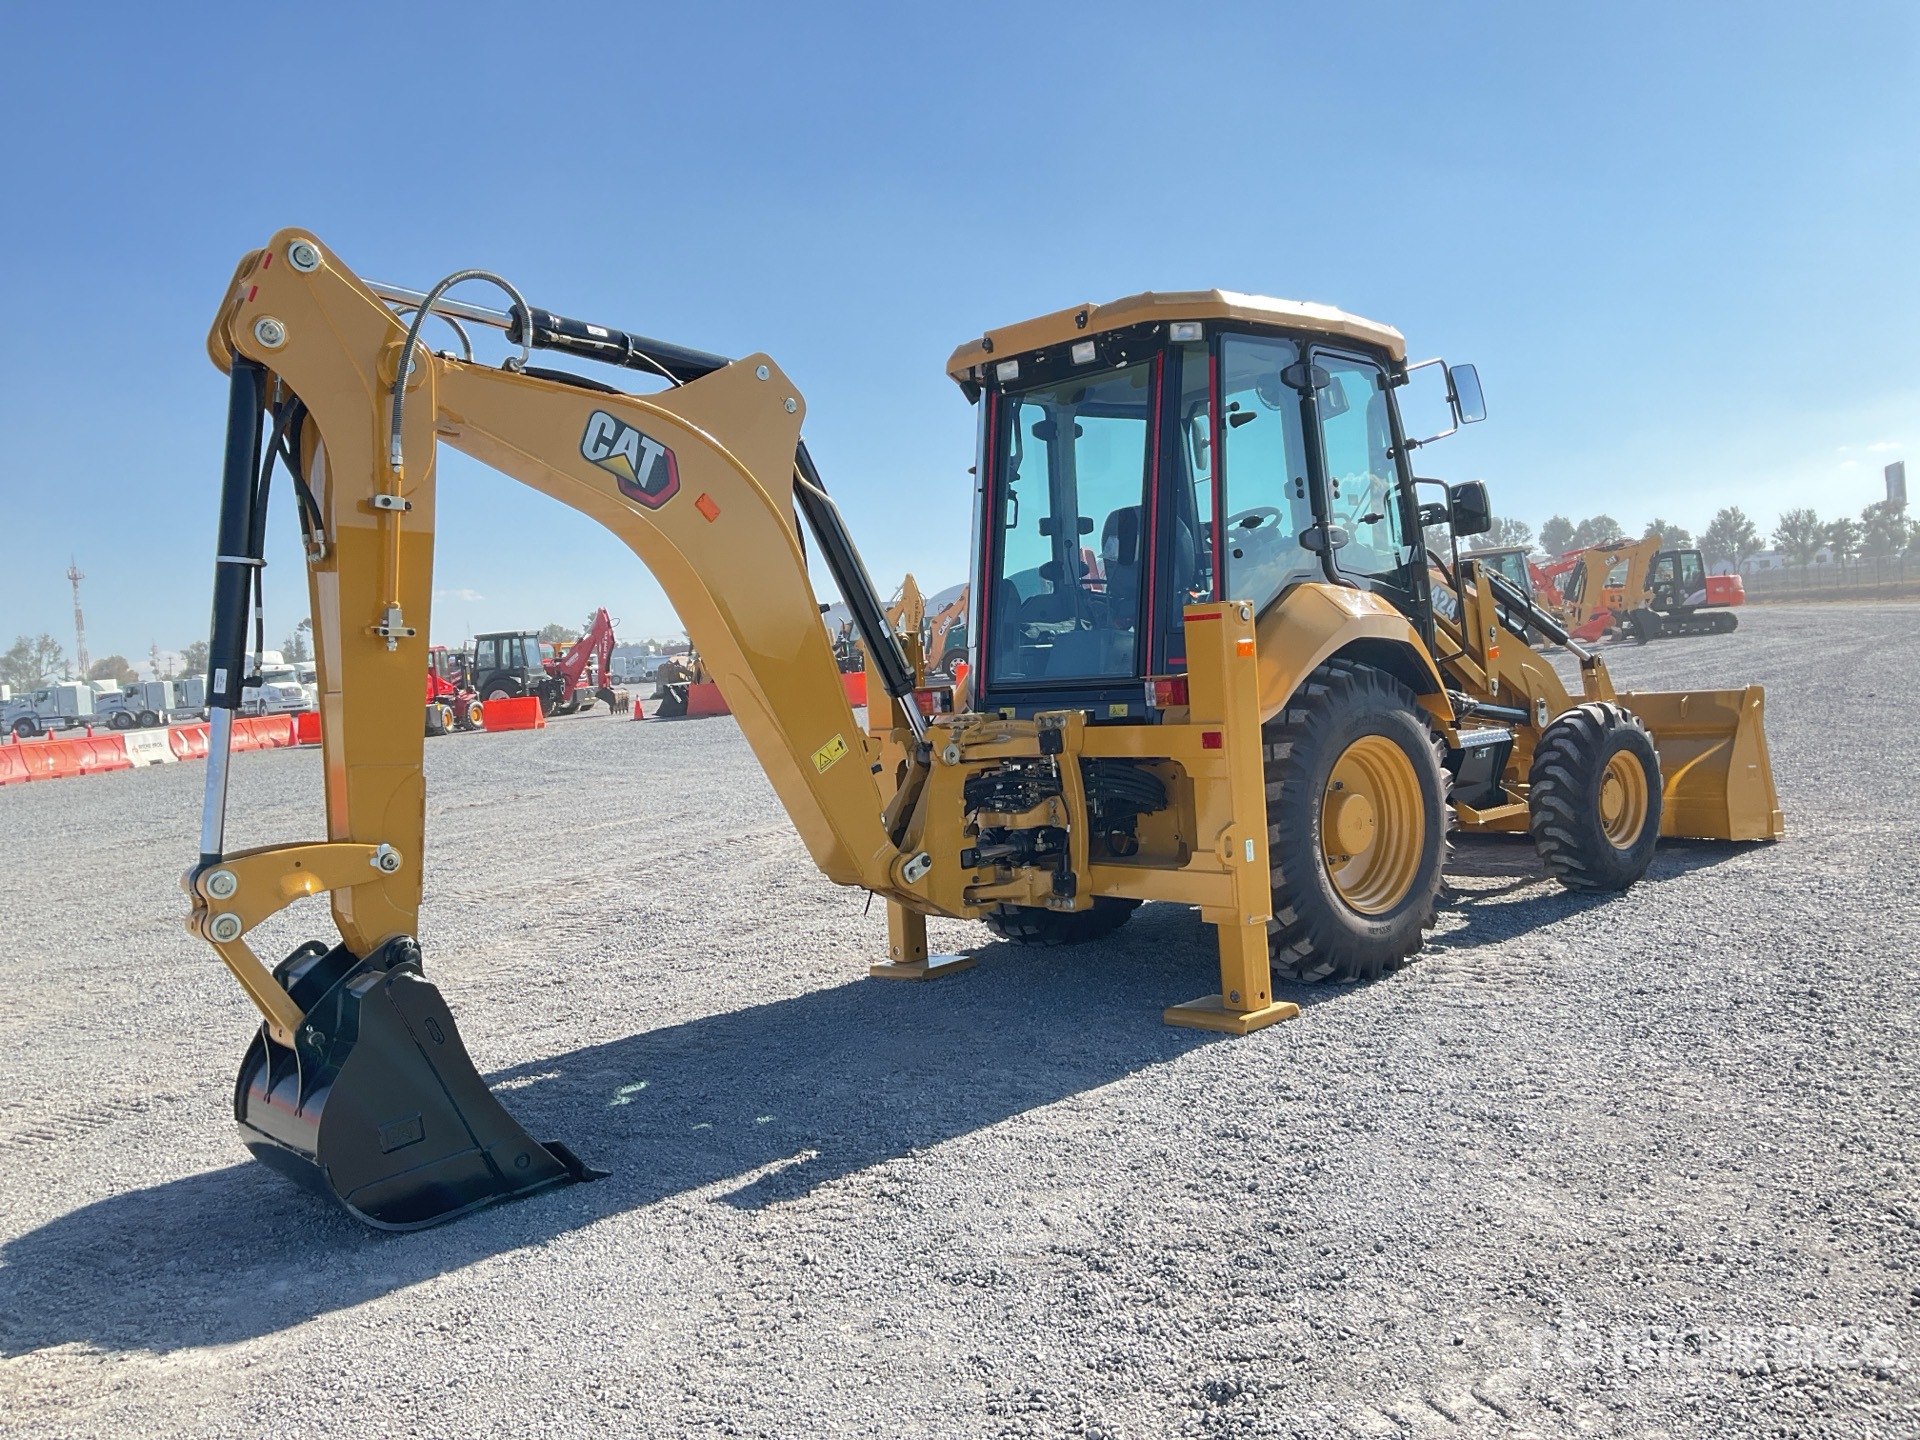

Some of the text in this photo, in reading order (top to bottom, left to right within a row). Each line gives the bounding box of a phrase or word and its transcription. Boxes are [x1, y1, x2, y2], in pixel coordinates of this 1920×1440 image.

[582, 412, 665, 488] CAT
[1431, 586, 1457, 620] 424
[938, 616, 952, 635] CASE
